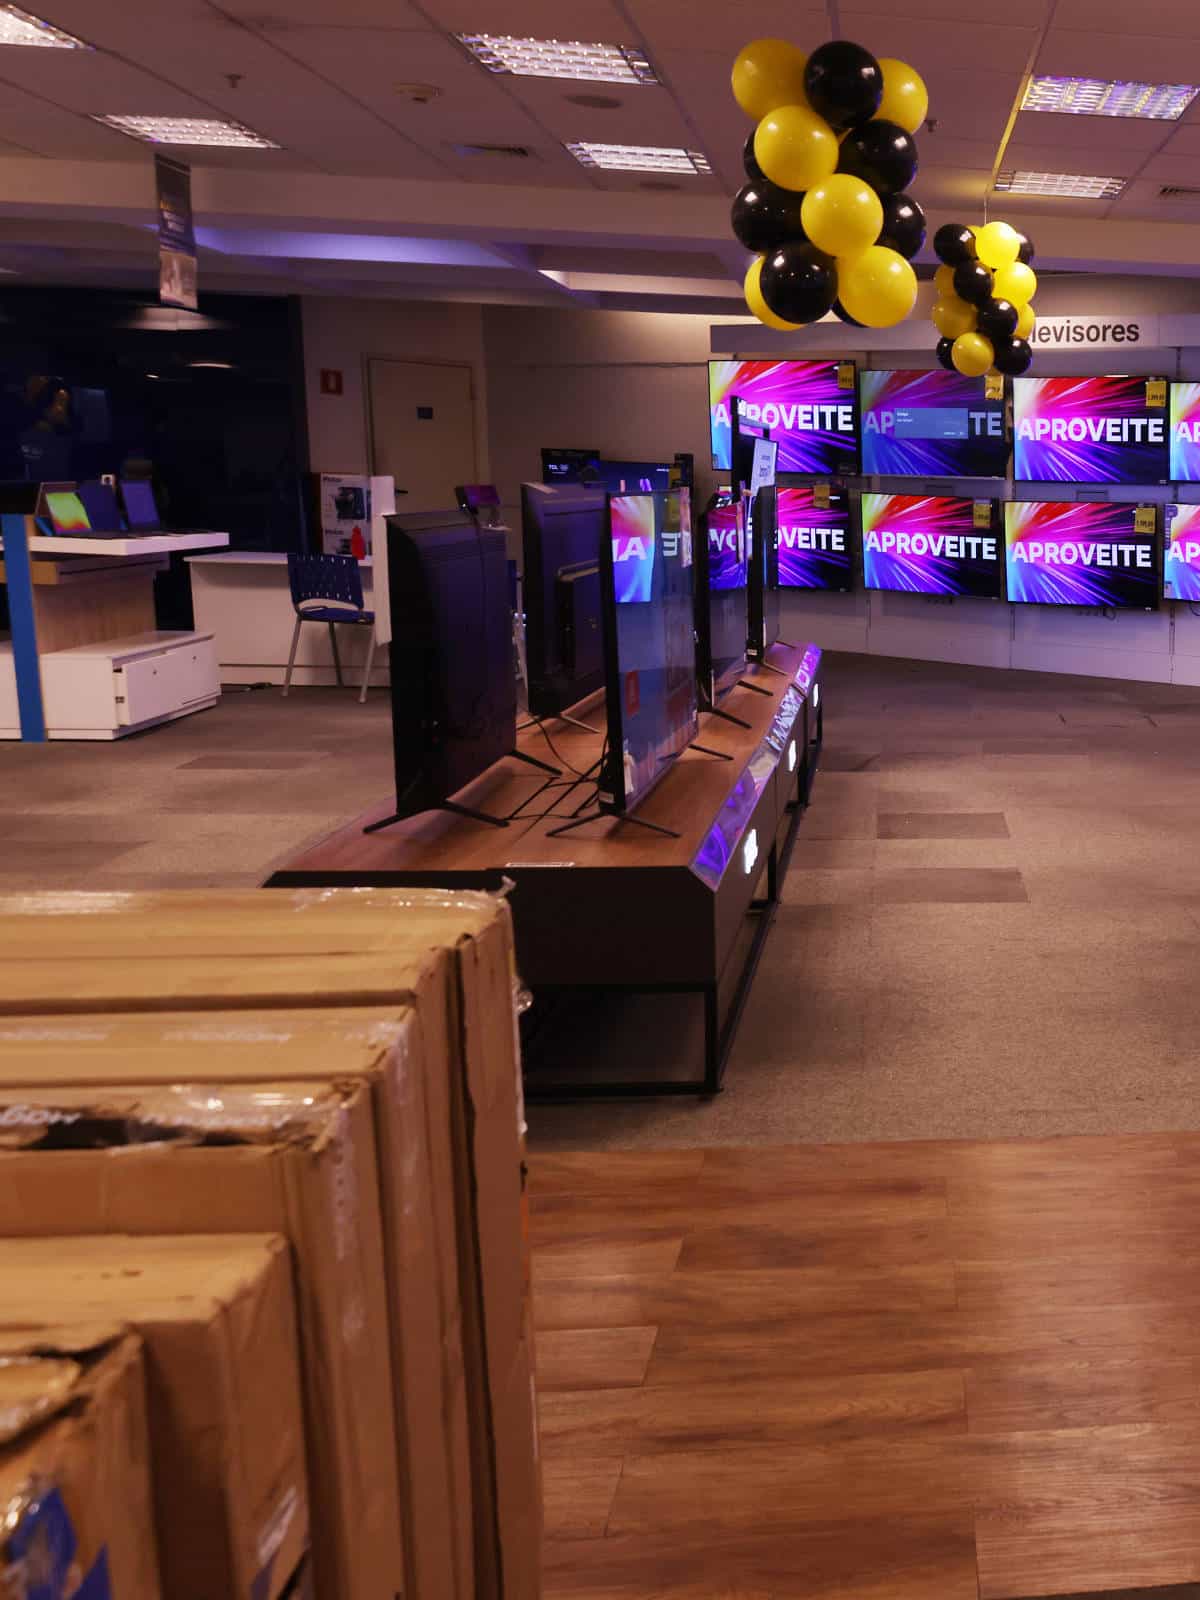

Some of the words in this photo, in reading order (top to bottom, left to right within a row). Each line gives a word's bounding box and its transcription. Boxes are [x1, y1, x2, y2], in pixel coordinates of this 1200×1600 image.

[1032, 319, 1140, 342] levisores
[714, 403, 853, 431] AROVEITE
[1016, 418, 1164, 442] APROVEITE
[865, 530, 997, 560] APROVEITE
[1011, 541, 1152, 568] APROVEITE
